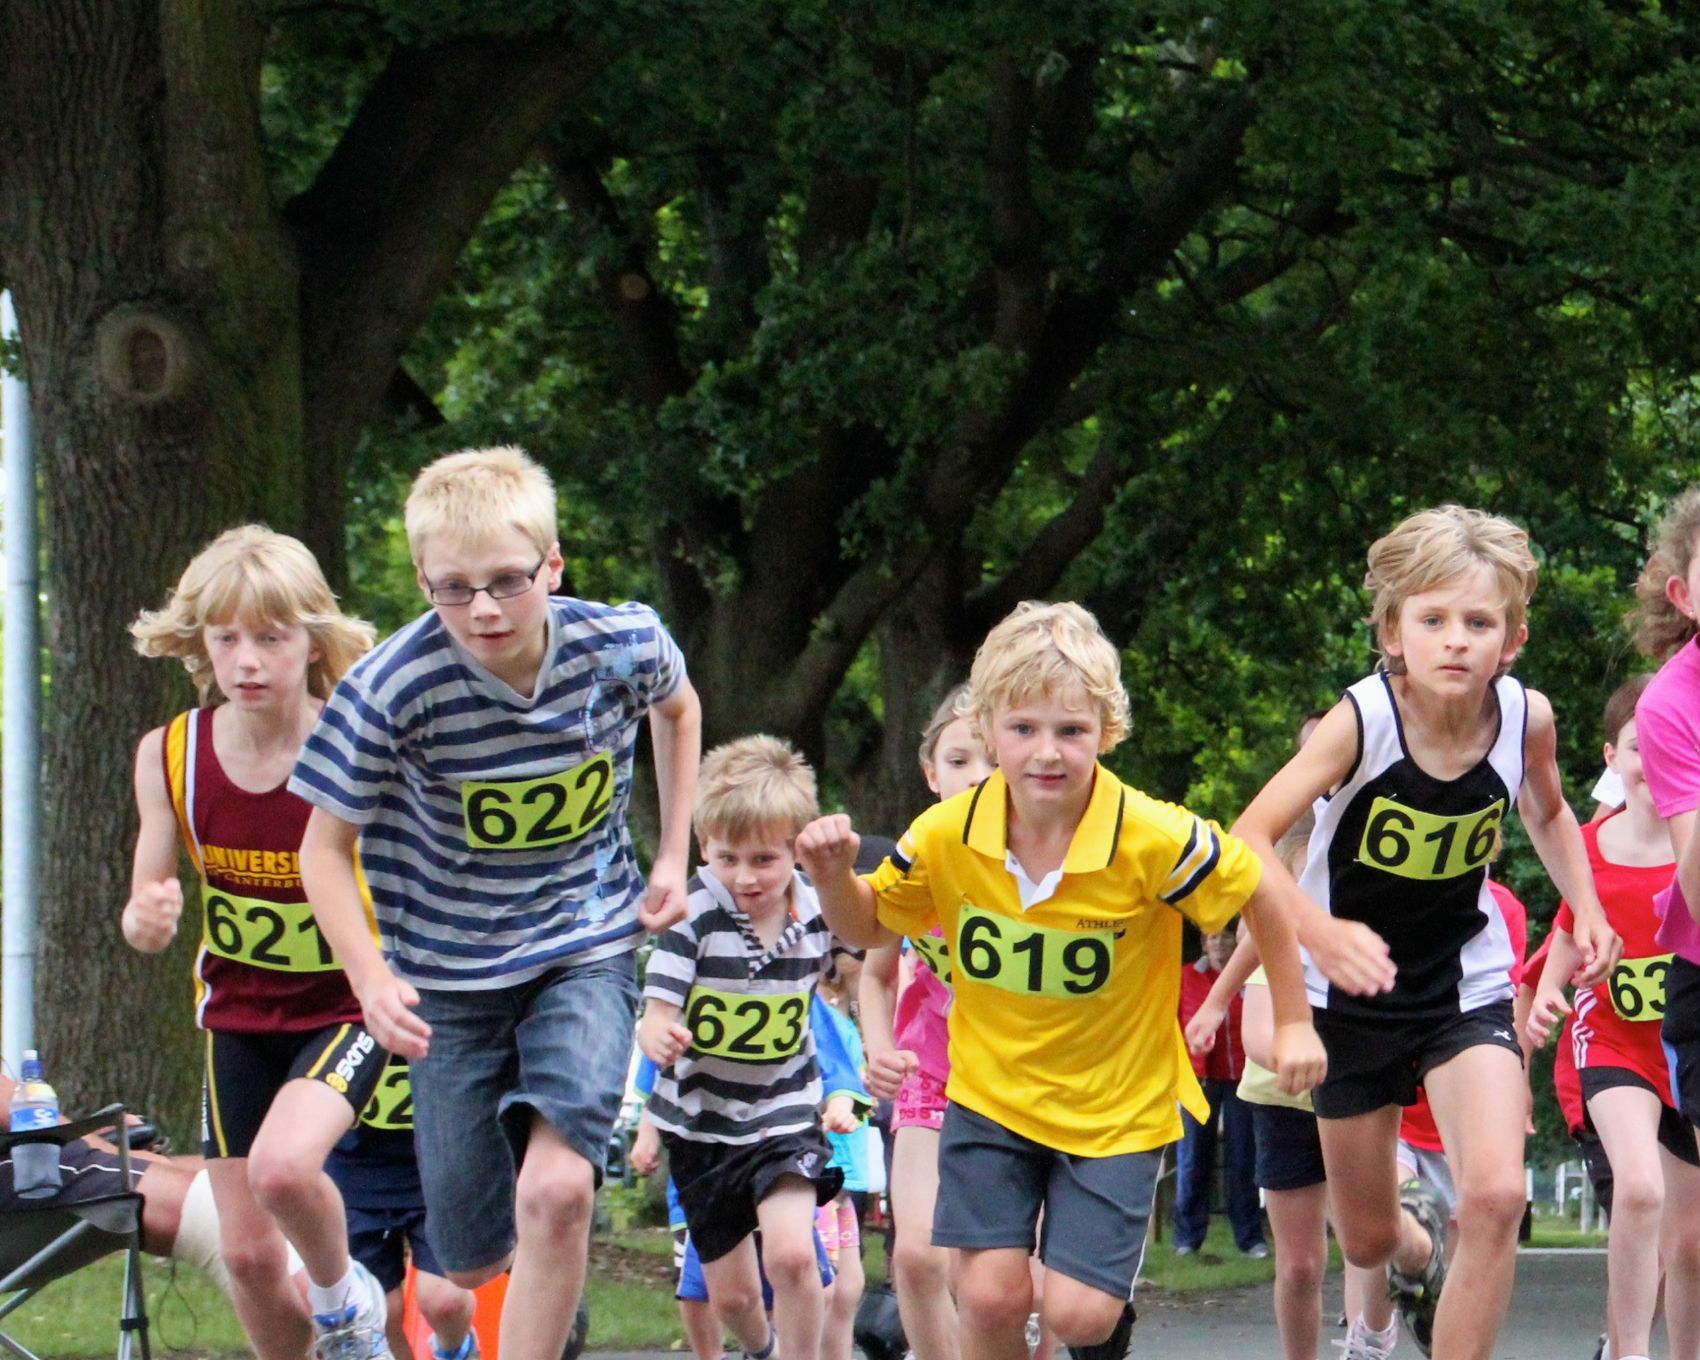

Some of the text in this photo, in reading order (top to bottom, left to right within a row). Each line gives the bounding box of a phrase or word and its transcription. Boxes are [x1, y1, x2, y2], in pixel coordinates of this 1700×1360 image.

[467, 759, 610, 845] 622
[1366, 808, 1500, 875] 616
[207, 895, 334, 966] 621
[959, 915, 1111, 994] 619
[688, 995, 804, 1054] 623
